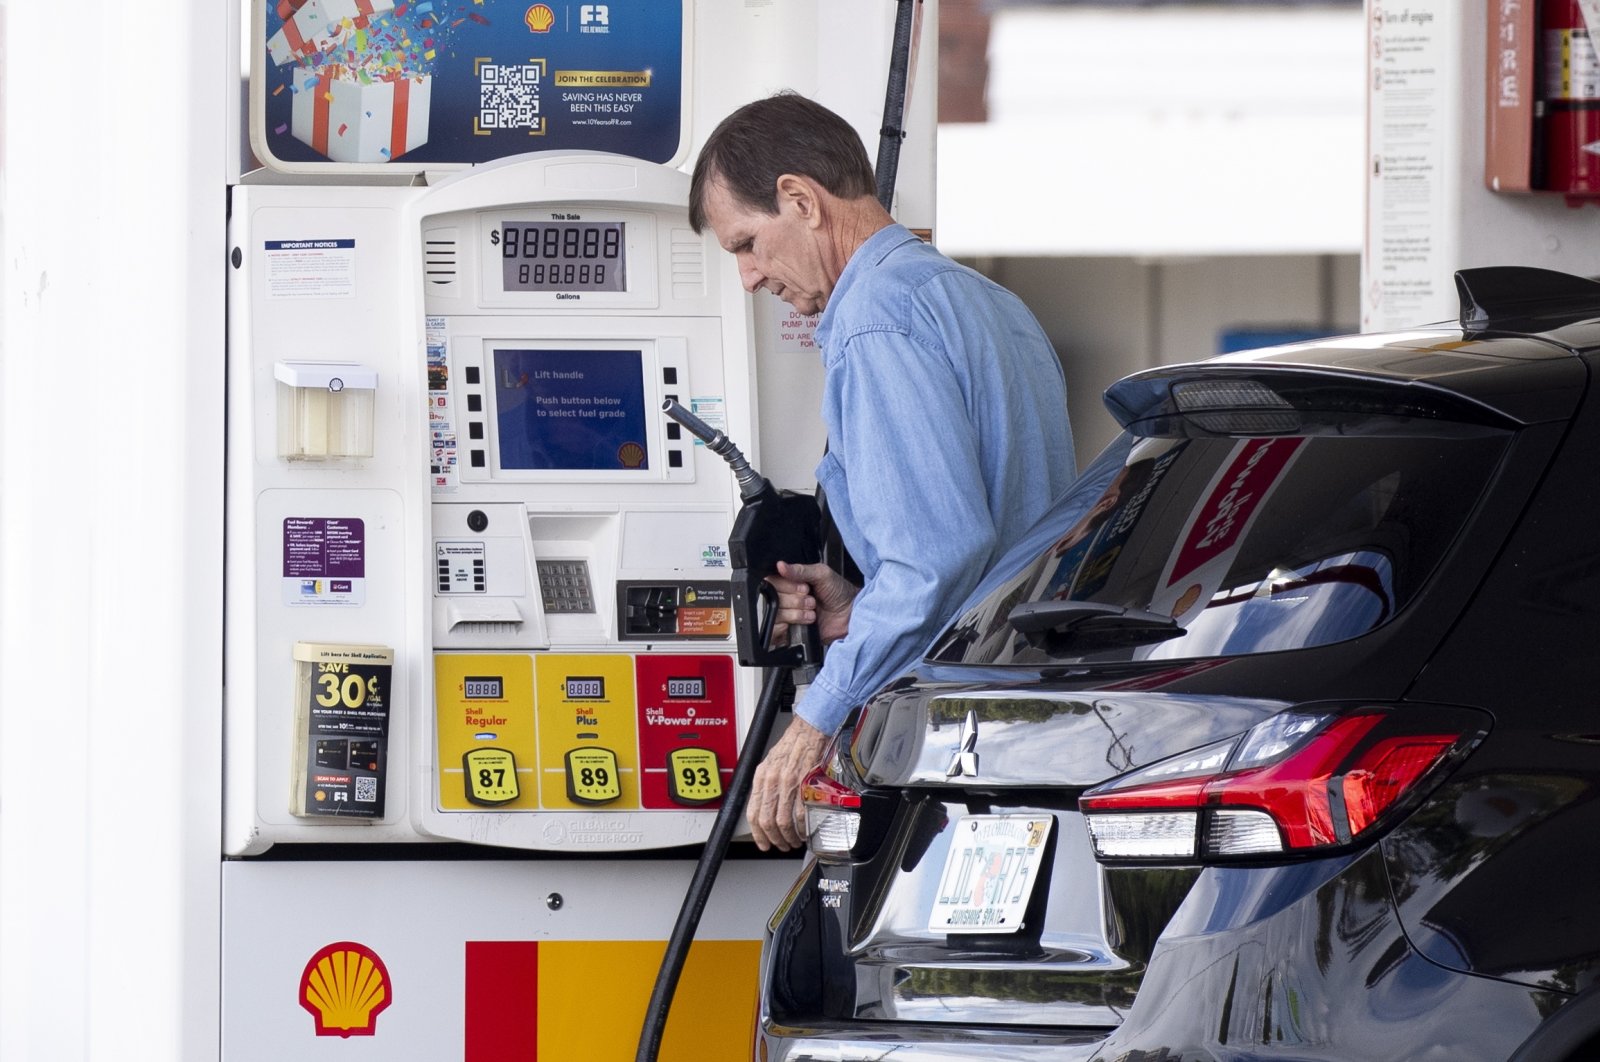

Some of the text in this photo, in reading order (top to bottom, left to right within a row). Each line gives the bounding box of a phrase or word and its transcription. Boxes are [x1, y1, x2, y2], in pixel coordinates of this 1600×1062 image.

[595, 76, 646, 84] CELEBRATION
[562, 93, 642, 102] SAVING HAS NEVER
[570, 104, 634, 113] BEEN THIS EASY
[491, 230, 500, 246] $
[535, 371, 584, 379] Lift handle
[536, 396, 621, 405] Push button below
[599, 410, 625, 419] grade
[318, 662, 349, 673] SAVE
[466, 716, 507, 727] Regular
[576, 716, 598, 725] Plus
[647, 716, 692, 726] V-Power
[479, 769, 506, 788] 87
[581, 768, 609, 786] 89
[682, 767, 711, 786] 93
[570, 821, 626, 831] GILBARCO
[570, 833, 643, 843] VEEDER-ROOT
[950, 909, 982, 925] SUNSHINE
